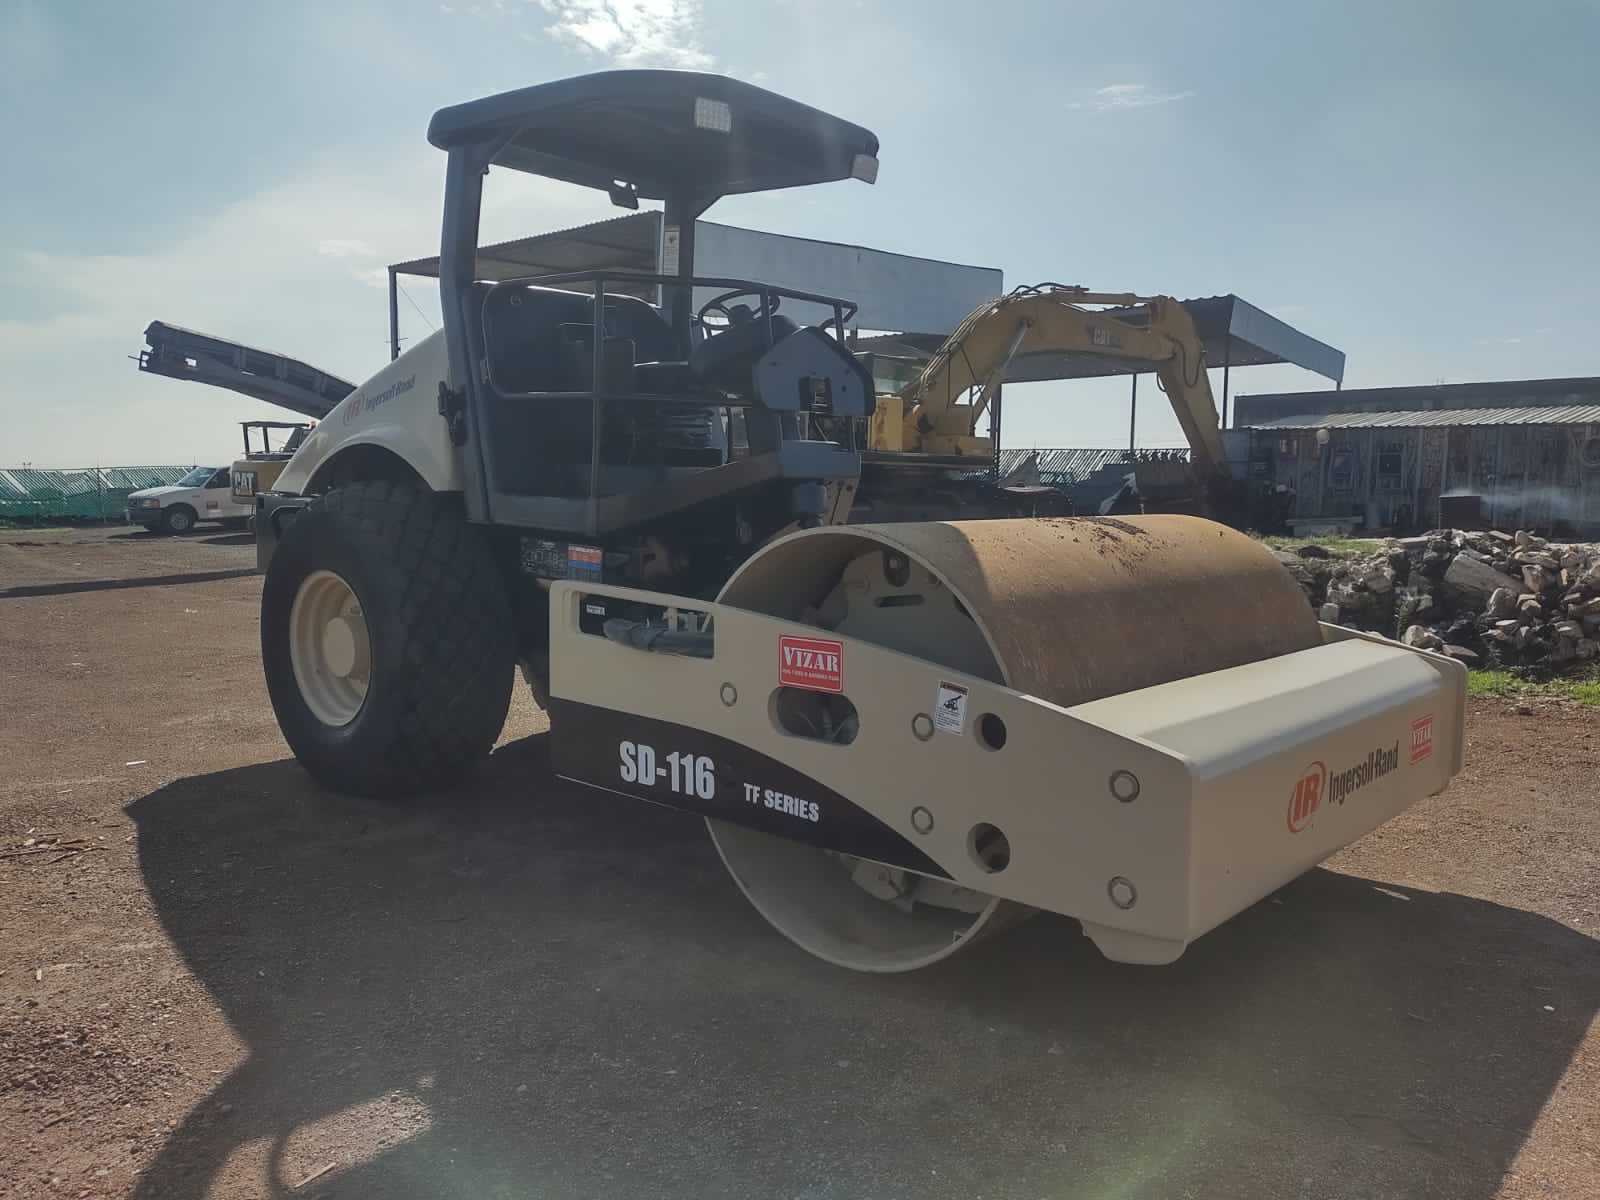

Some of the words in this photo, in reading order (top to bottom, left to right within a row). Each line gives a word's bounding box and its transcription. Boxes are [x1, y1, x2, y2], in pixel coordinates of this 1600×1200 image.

[234, 472, 255, 496] CAT
[783, 646, 838, 673] VIZAR
[619, 741, 715, 800] SD-116
[1328, 751, 1375, 806] Ingersoll
[743, 782, 761, 804] TF
[764, 788, 820, 823] SERIES
